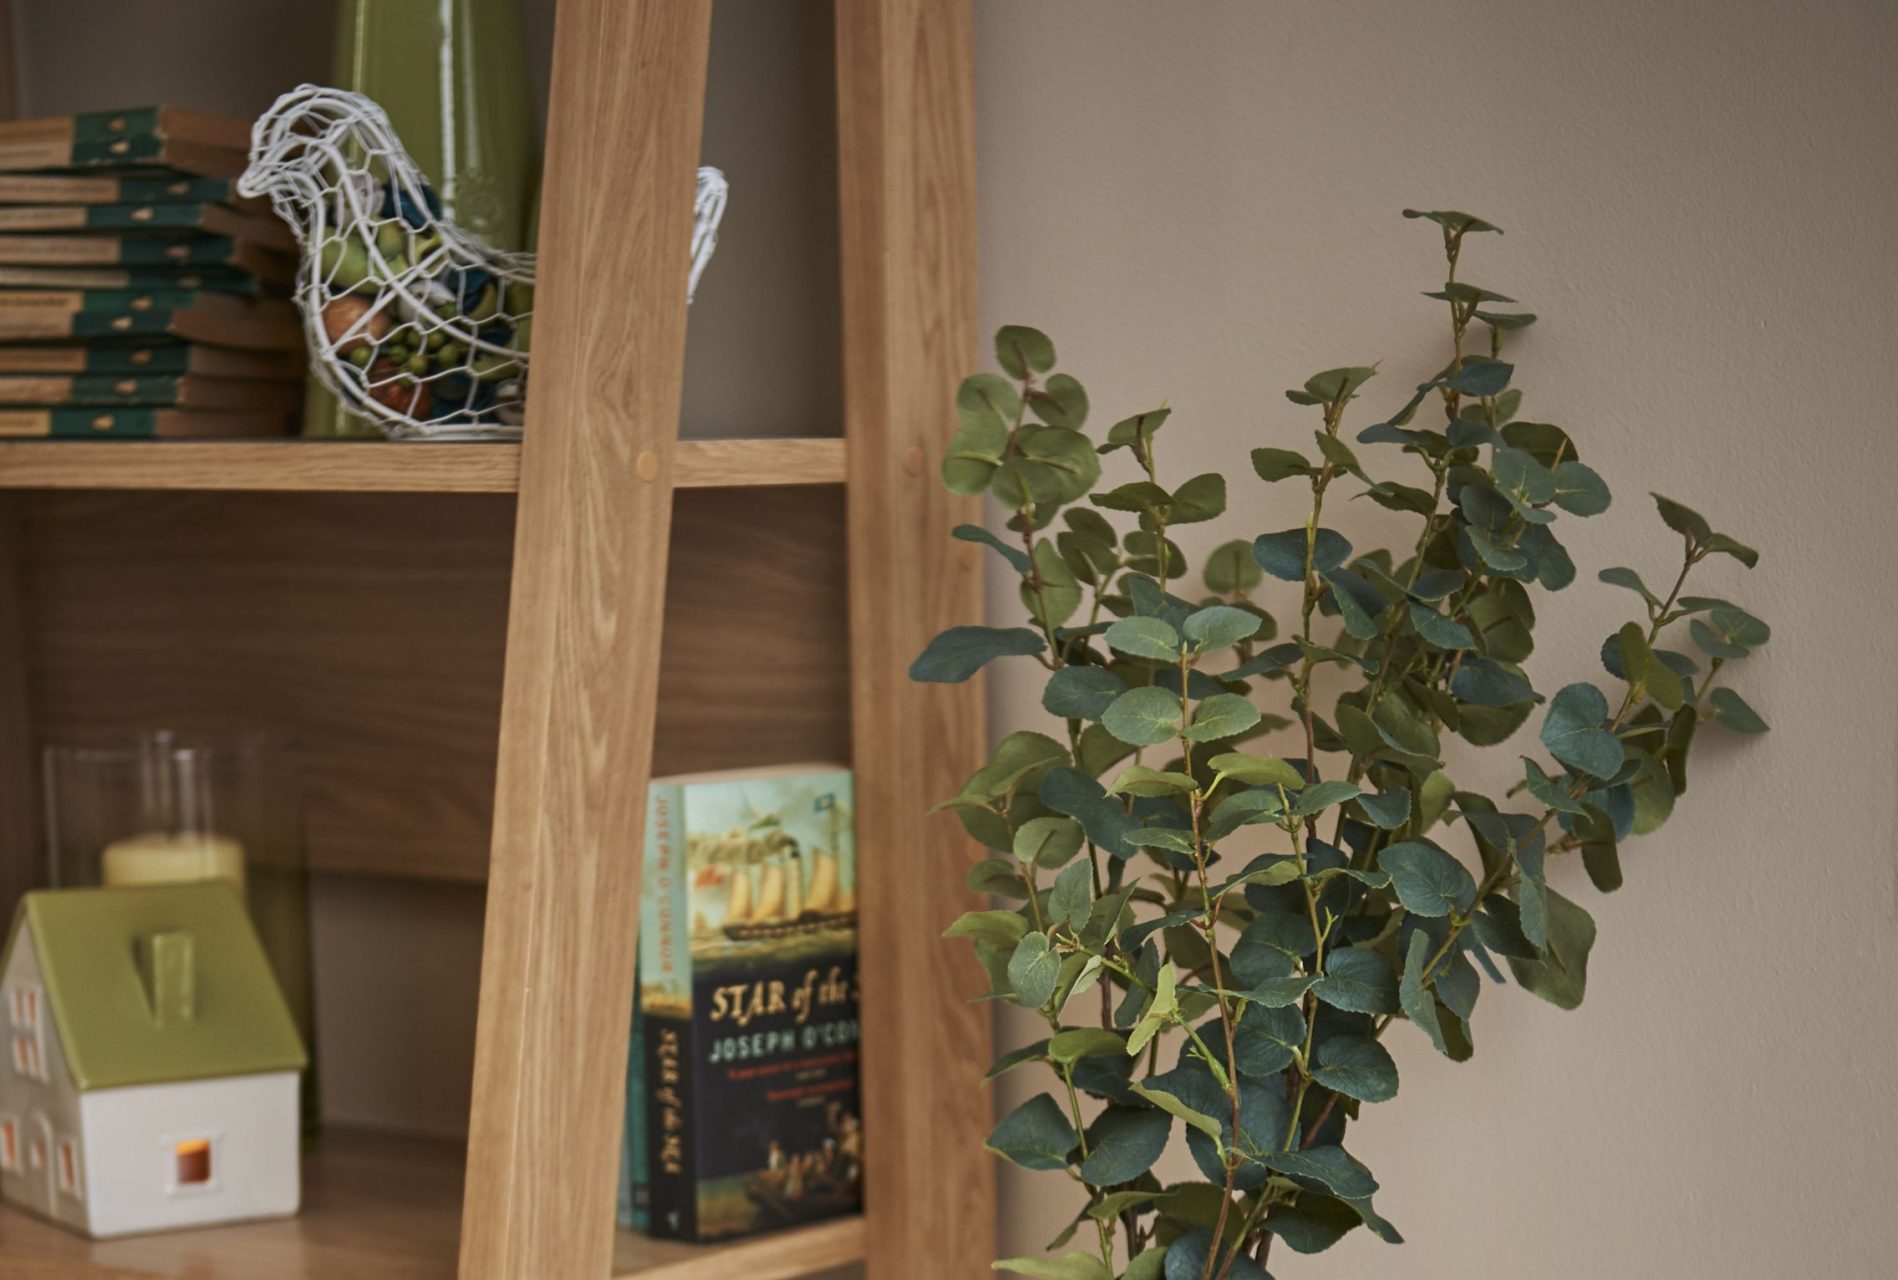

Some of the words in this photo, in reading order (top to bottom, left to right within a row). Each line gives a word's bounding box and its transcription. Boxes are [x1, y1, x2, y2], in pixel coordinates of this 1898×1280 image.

[655, 796, 670, 871] JOSEPH
[710, 982, 785, 1026] STAR
[793, 970, 818, 1023] of
[819, 967, 848, 1005] the
[709, 1029, 795, 1063] JOSEPH
